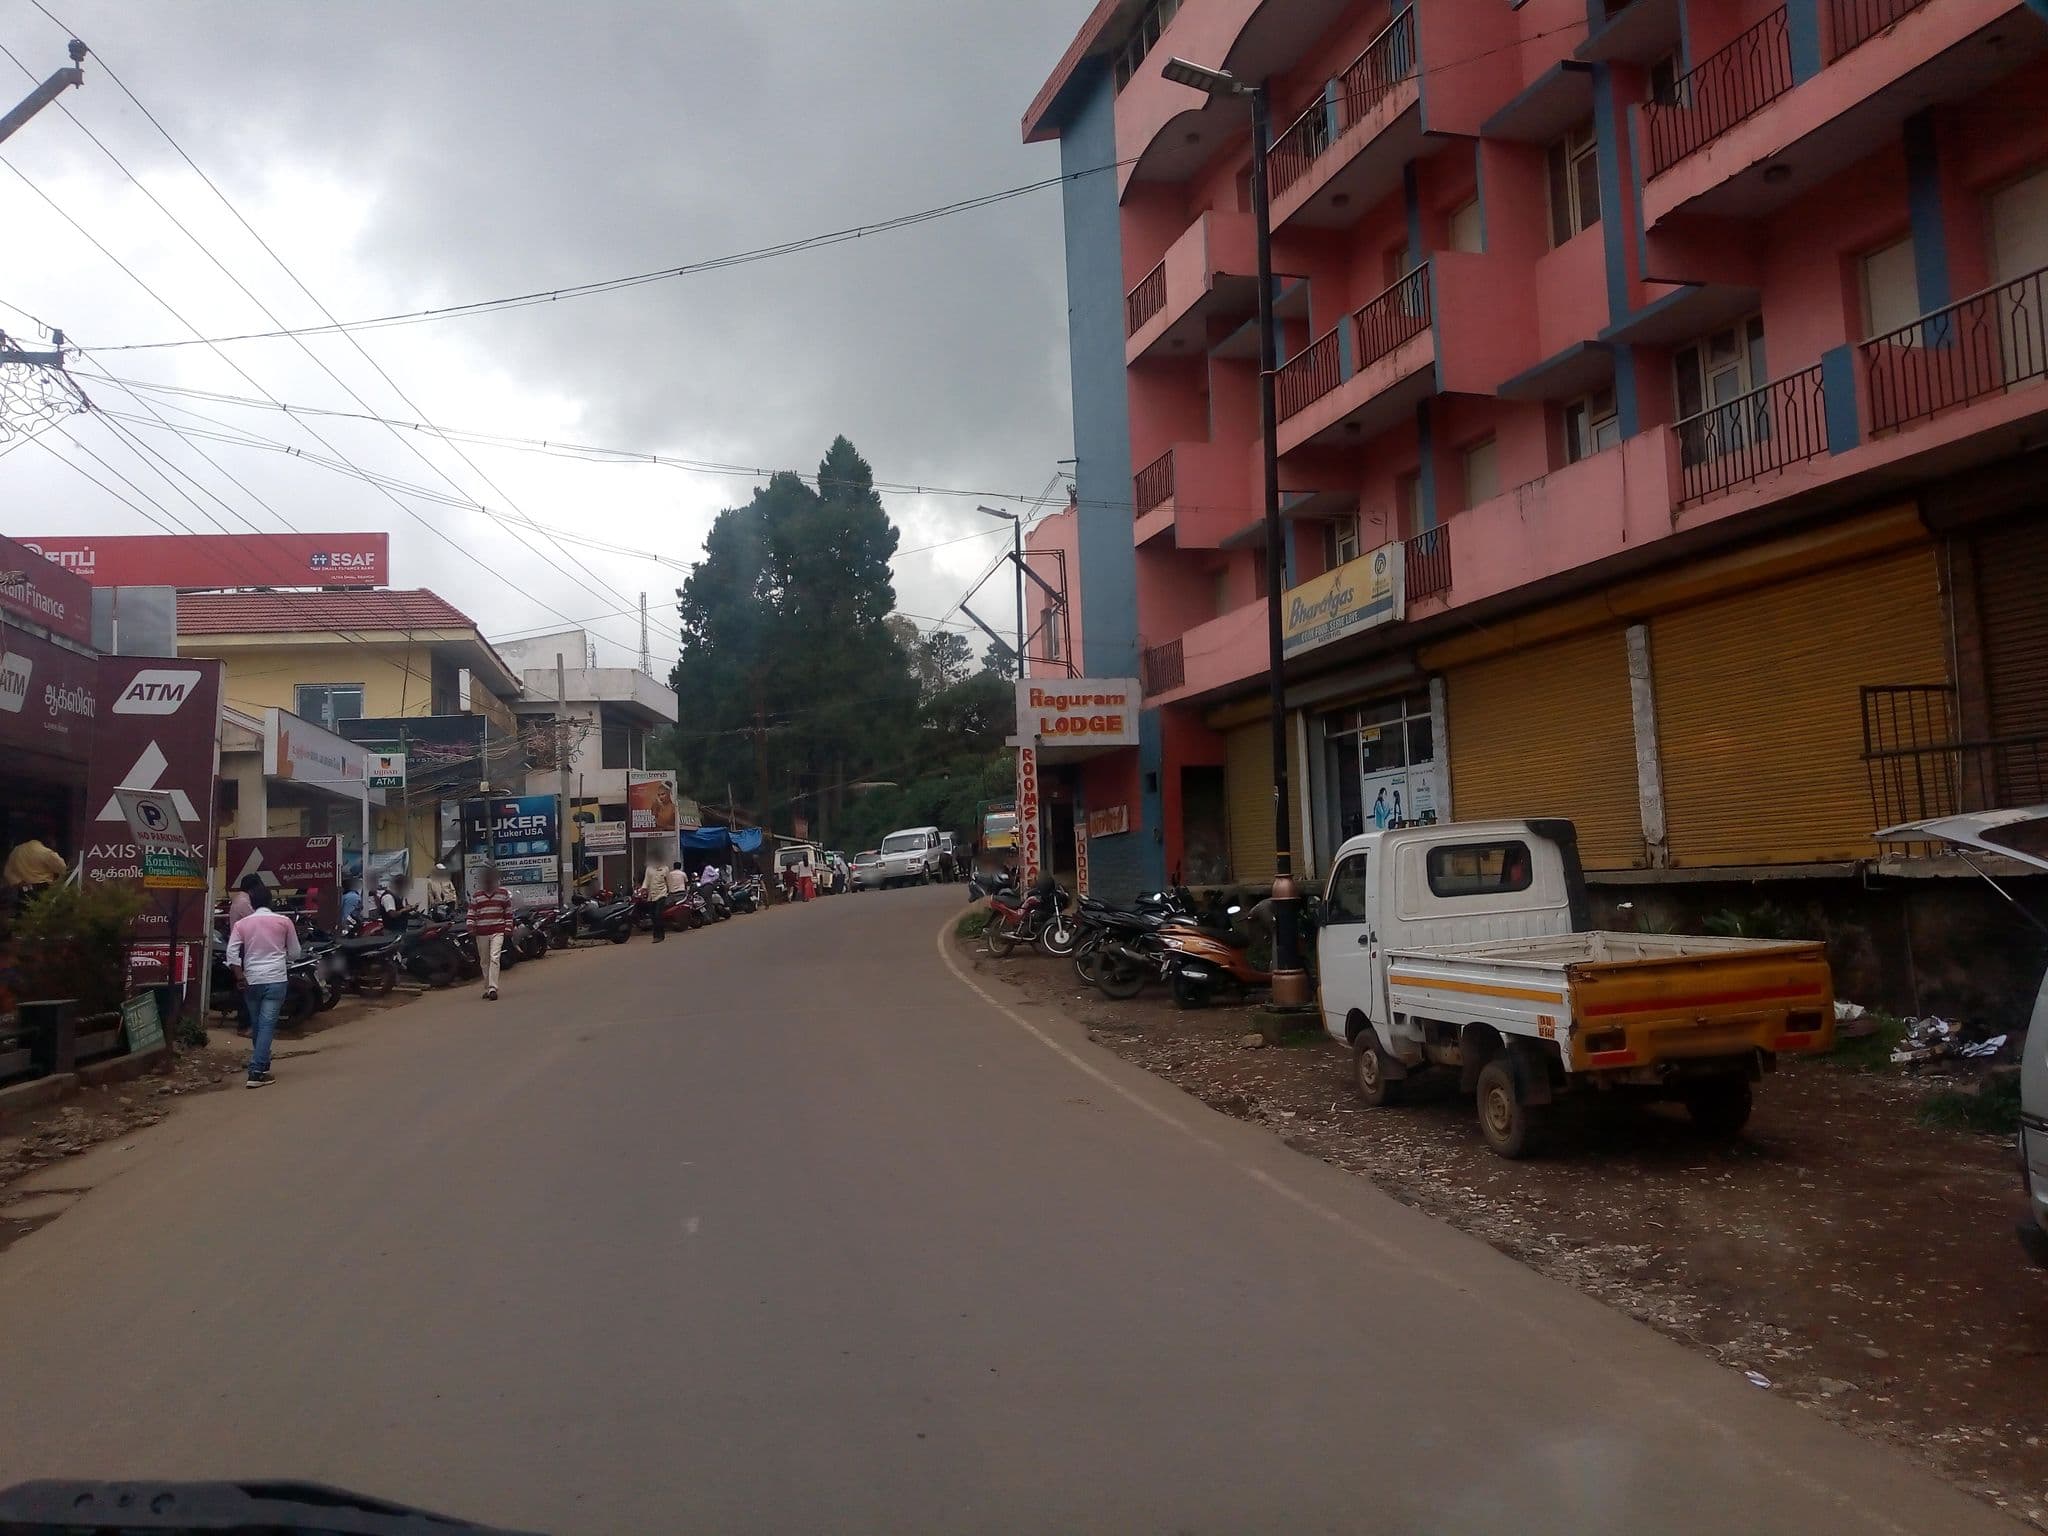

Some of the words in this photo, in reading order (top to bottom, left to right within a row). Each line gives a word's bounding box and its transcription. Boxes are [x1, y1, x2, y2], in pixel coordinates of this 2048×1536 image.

[331, 552, 375, 567] ESAF
[26, 582, 65, 621] Finance
[125, 682, 186, 702] ATM
[1029, 687, 1126, 711] Raguram
[1040, 715, 1125, 736] LODGE
[648, 771, 668, 779] trends
[1022, 748, 1039, 821] ROOMS
[137, 831, 150, 842] NO
[151, 832, 185, 845] PARKING
[498, 828, 523, 838] Luker
[524, 826, 544, 836] USA
[310, 838, 328, 847] ATM
[87, 843, 137, 859] AXIS
[280, 862, 303, 871] AXIS
[305, 861, 333, 870] BANK
[519, 857, 552, 865] AGENCIES
